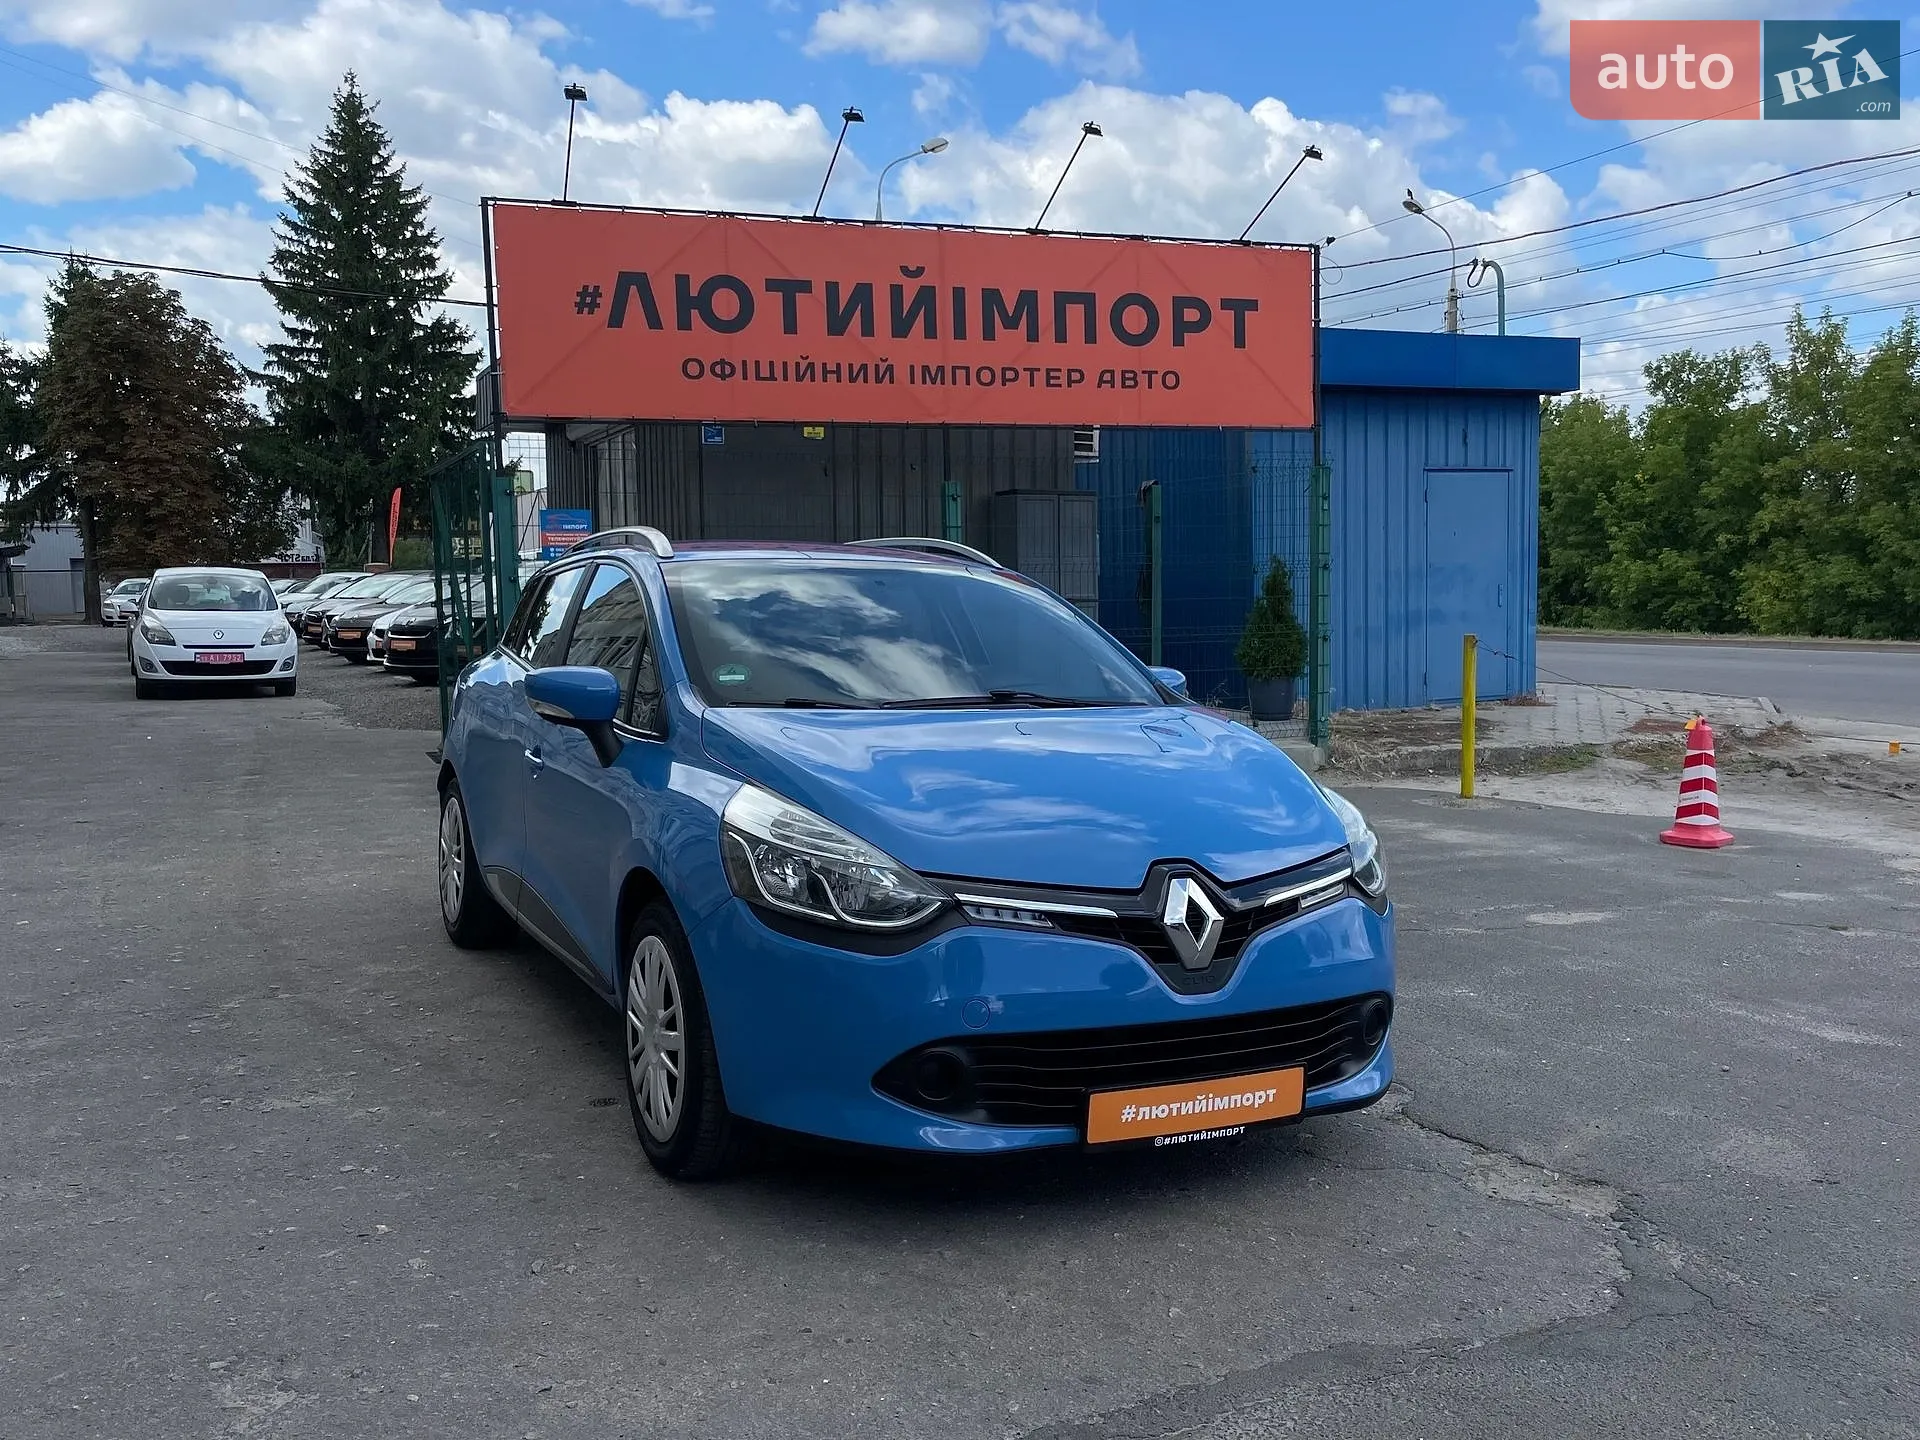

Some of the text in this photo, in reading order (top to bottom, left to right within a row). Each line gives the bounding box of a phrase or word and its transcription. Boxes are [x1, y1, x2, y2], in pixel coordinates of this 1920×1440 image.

[574, 265, 1260, 349] #ЛЮТИЙІМПОРТ
[681, 354, 1181, 391] ОФІЦІЙНИЙ ІМПОРТЕР АВТО
[1120, 1087, 1277, 1123] #лютийімпорт
